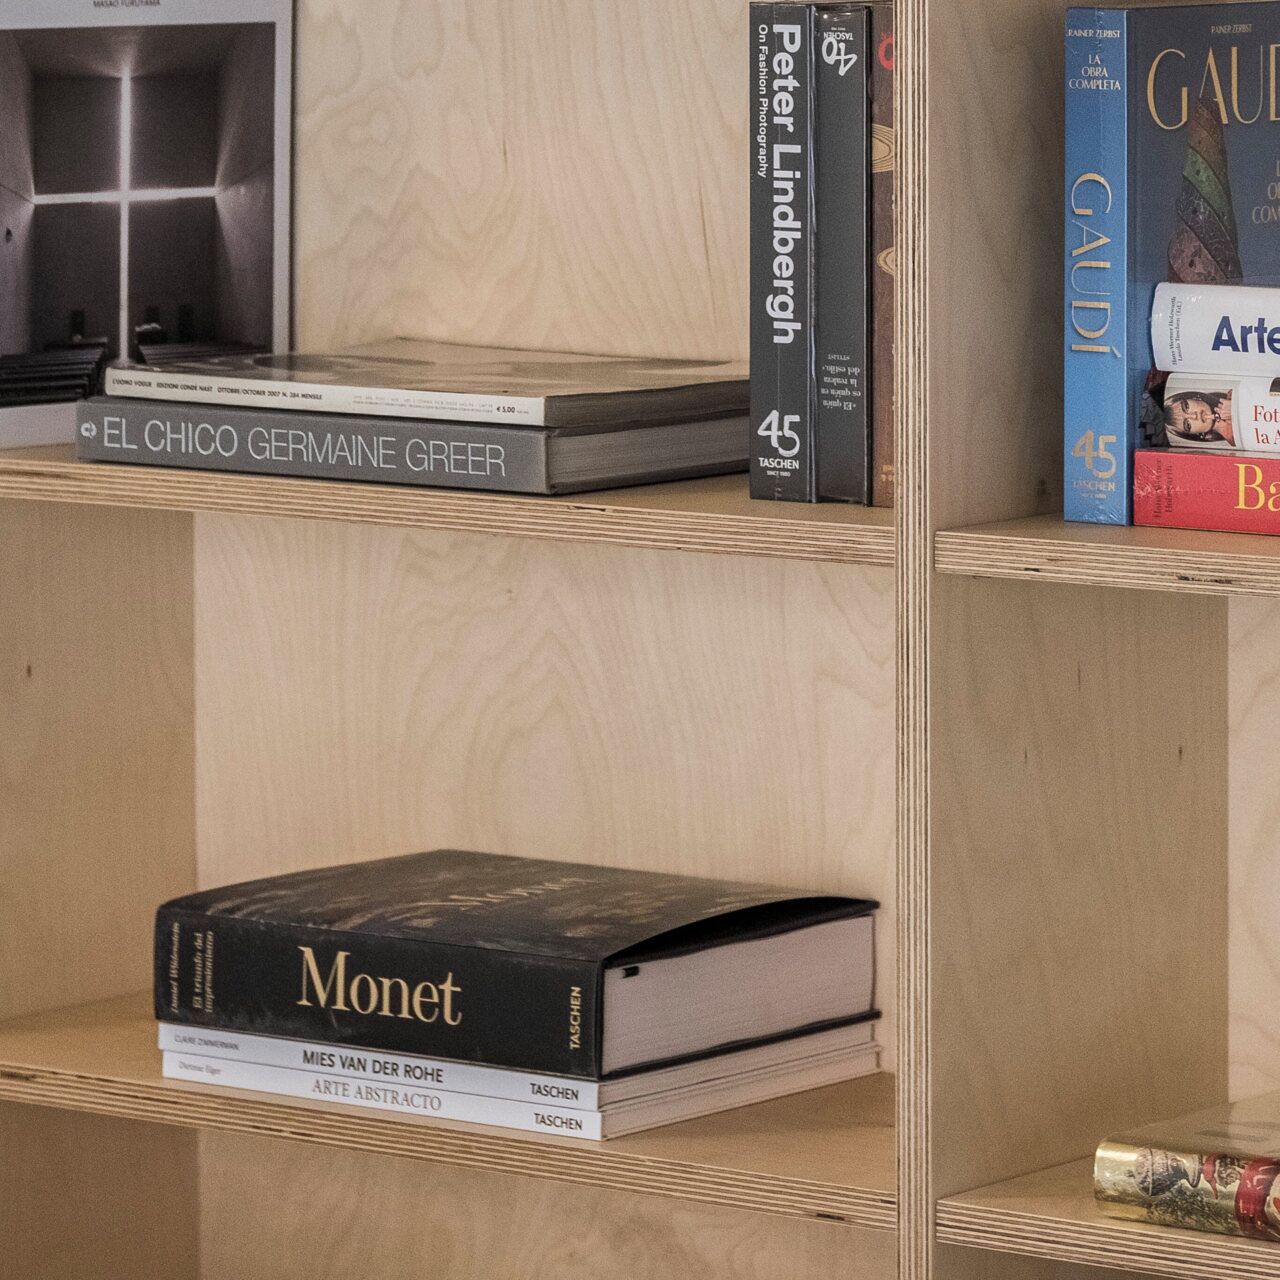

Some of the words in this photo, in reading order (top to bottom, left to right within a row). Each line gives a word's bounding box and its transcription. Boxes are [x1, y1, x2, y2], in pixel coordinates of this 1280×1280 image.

[759, 24, 769, 43] On
[823, 32, 854, 41] TASCHEN
[1068, 28, 1094, 38] RAINER
[1095, 28, 1121, 39] ZERBST
[1211, 25, 1230, 34] RAINER
[1231, 23, 1252, 33] ZERBST
[759, 46, 769, 94] Fashion
[821, 37, 858, 77] 40
[1081, 66, 1108, 78] OBRA
[1088, 53, 1101, 65] LA
[772, 24, 801, 132] Peter
[1069, 78, 1121, 91] COMPLETA
[757, 97, 769, 178] Photography
[766, 143, 802, 344] Lindbergh
[1071, 172, 1121, 358] GAUDÍ
[103, 417, 138, 450] EL
[144, 419, 238, 457] CHICO
[247, 426, 397, 469] GERMAINE
[405, 438, 507, 477] GREER
[757, 409, 800, 458] 45
[1254, 428, 1270, 444] la
[758, 457, 800, 470] TASCHEN
[1072, 429, 1117, 479] 45
[296, 945, 462, 1025] Monet
[569, 986, 582, 1050] TASCHEN
[303, 1050, 336, 1068] MIES
[339, 1054, 367, 1073] VAN
[372, 1059, 399, 1077] DER
[404, 1064, 444, 1083] ROHE
[312, 1079, 350, 1098] ARTE
[354, 1085, 442, 1111] ABSTRACTO
[530, 1081, 579, 1102] TASCHEN
[534, 1111, 583, 1132] TASCHEN
